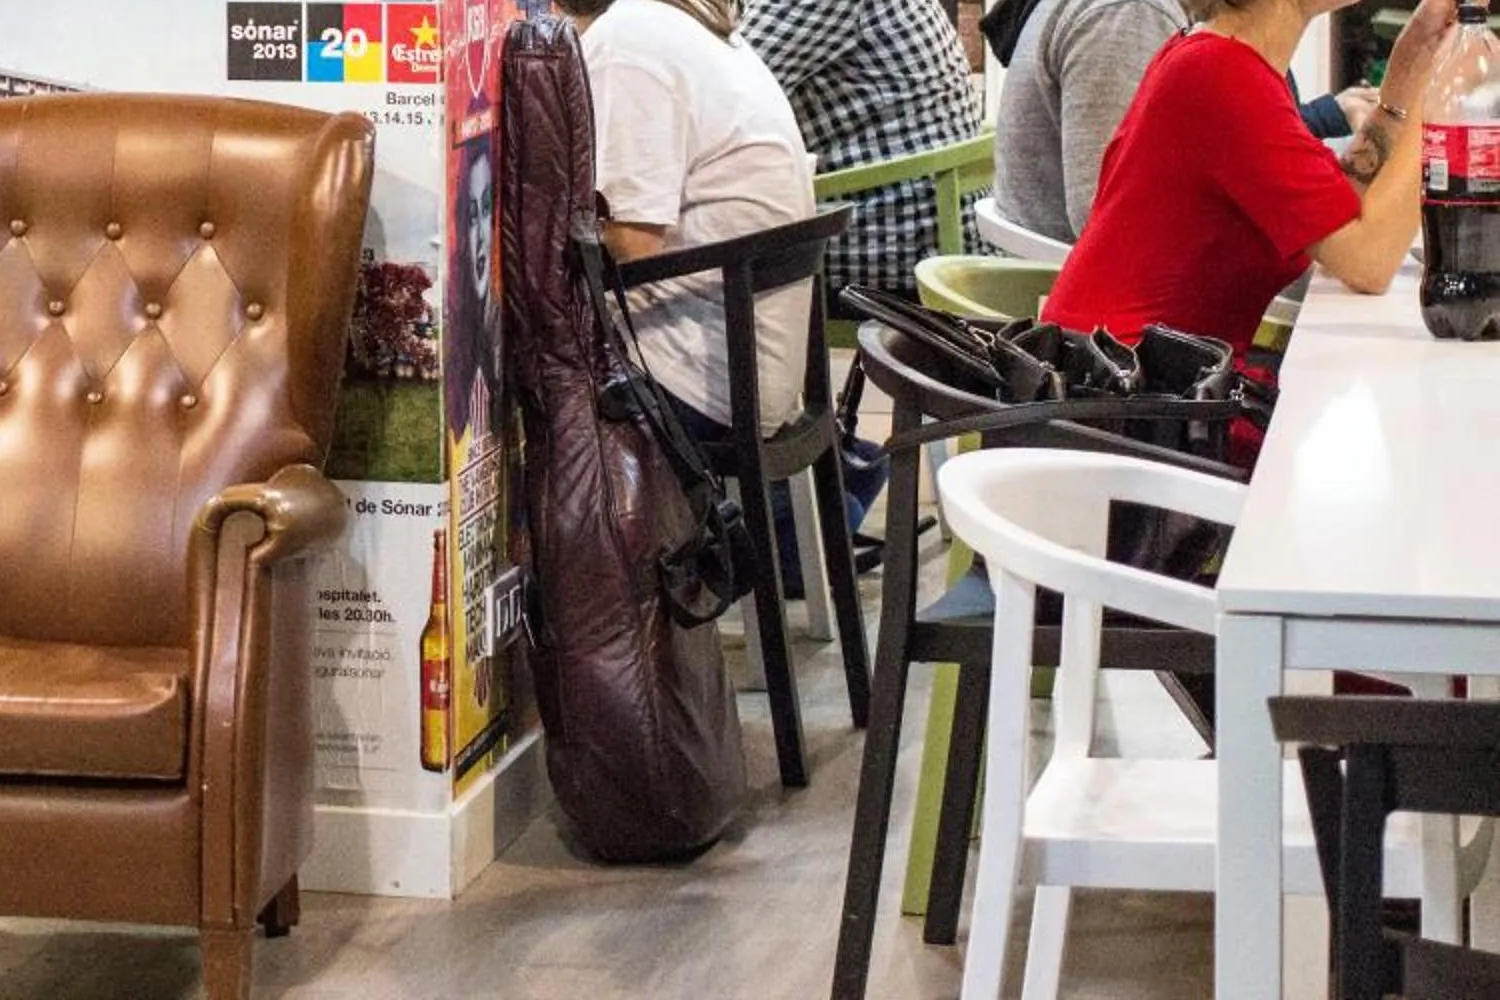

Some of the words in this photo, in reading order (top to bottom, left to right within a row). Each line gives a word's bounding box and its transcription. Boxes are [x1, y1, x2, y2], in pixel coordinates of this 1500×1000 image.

[320, 27, 368, 59] 20
[253, 43, 297, 60] 2013
[356, 498, 377, 514] de
[319, 607, 341, 621] les
